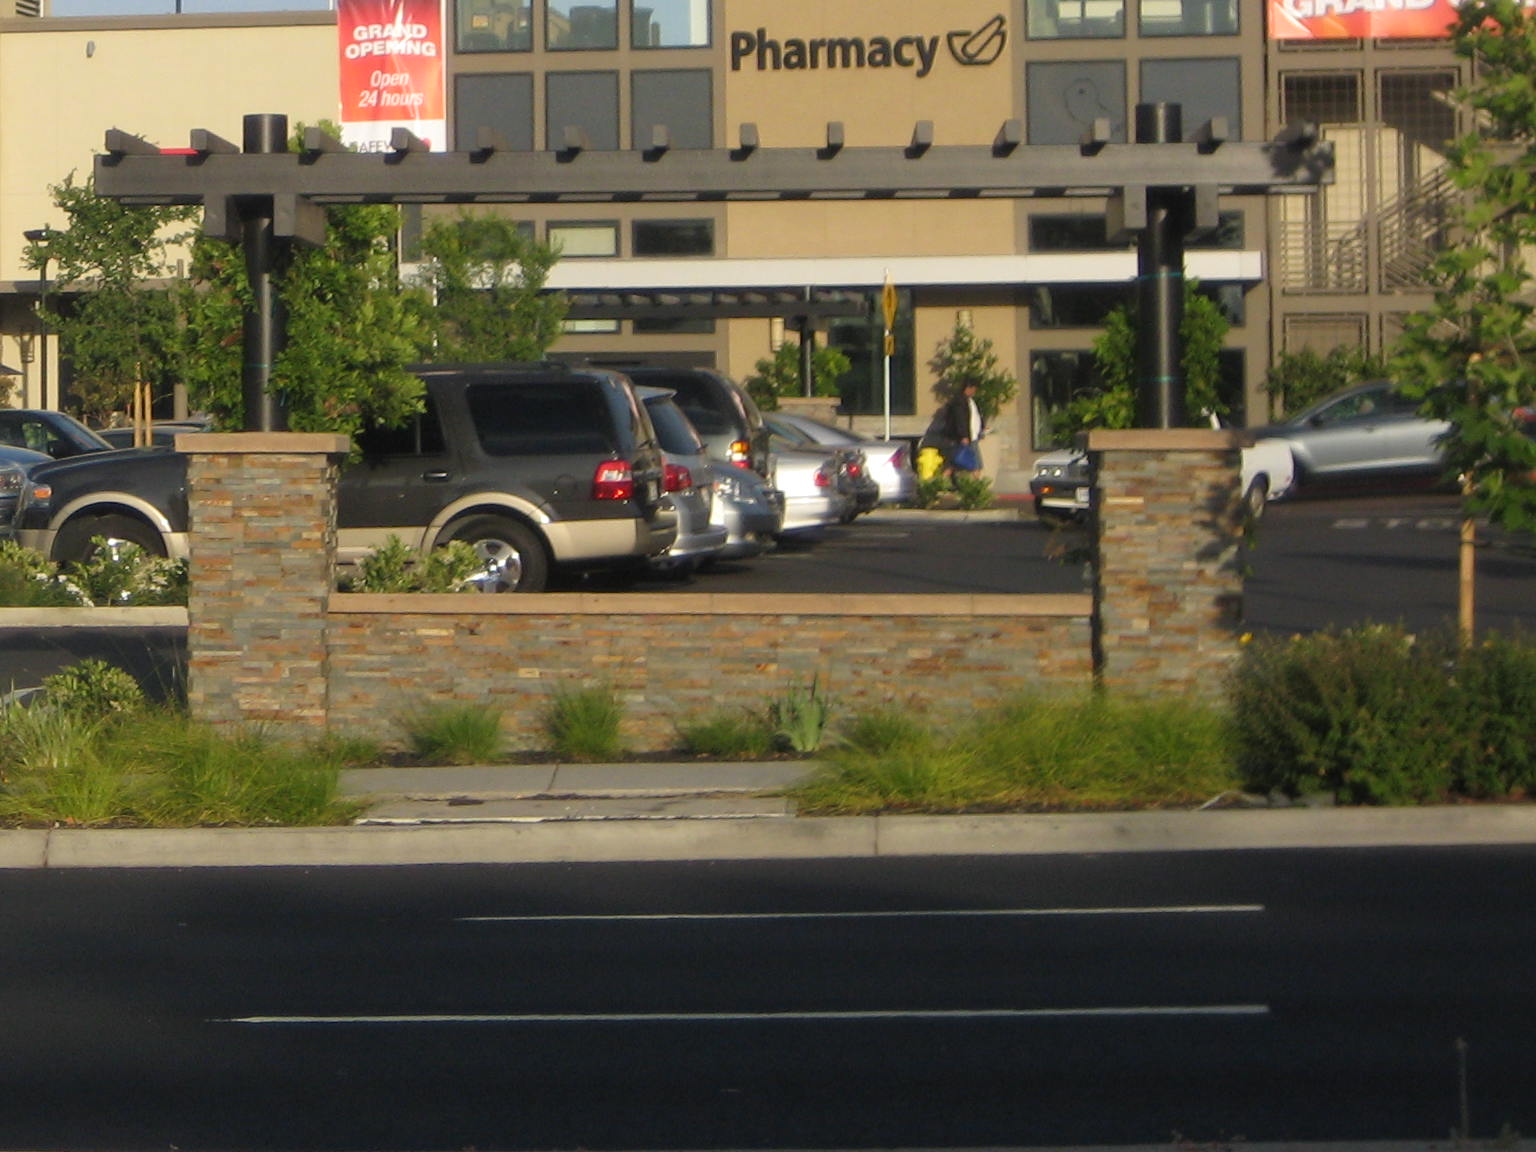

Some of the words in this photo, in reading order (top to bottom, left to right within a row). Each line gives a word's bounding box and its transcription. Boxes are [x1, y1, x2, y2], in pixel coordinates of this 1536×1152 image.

[352, 23, 428, 41] GRAND
[345, 40, 437, 60] OPENING
[730, 27, 940, 79] Pharmacy
[370, 70, 410, 90] Open
[358, 89, 379, 108] 24
[380, 89, 425, 107] hours
